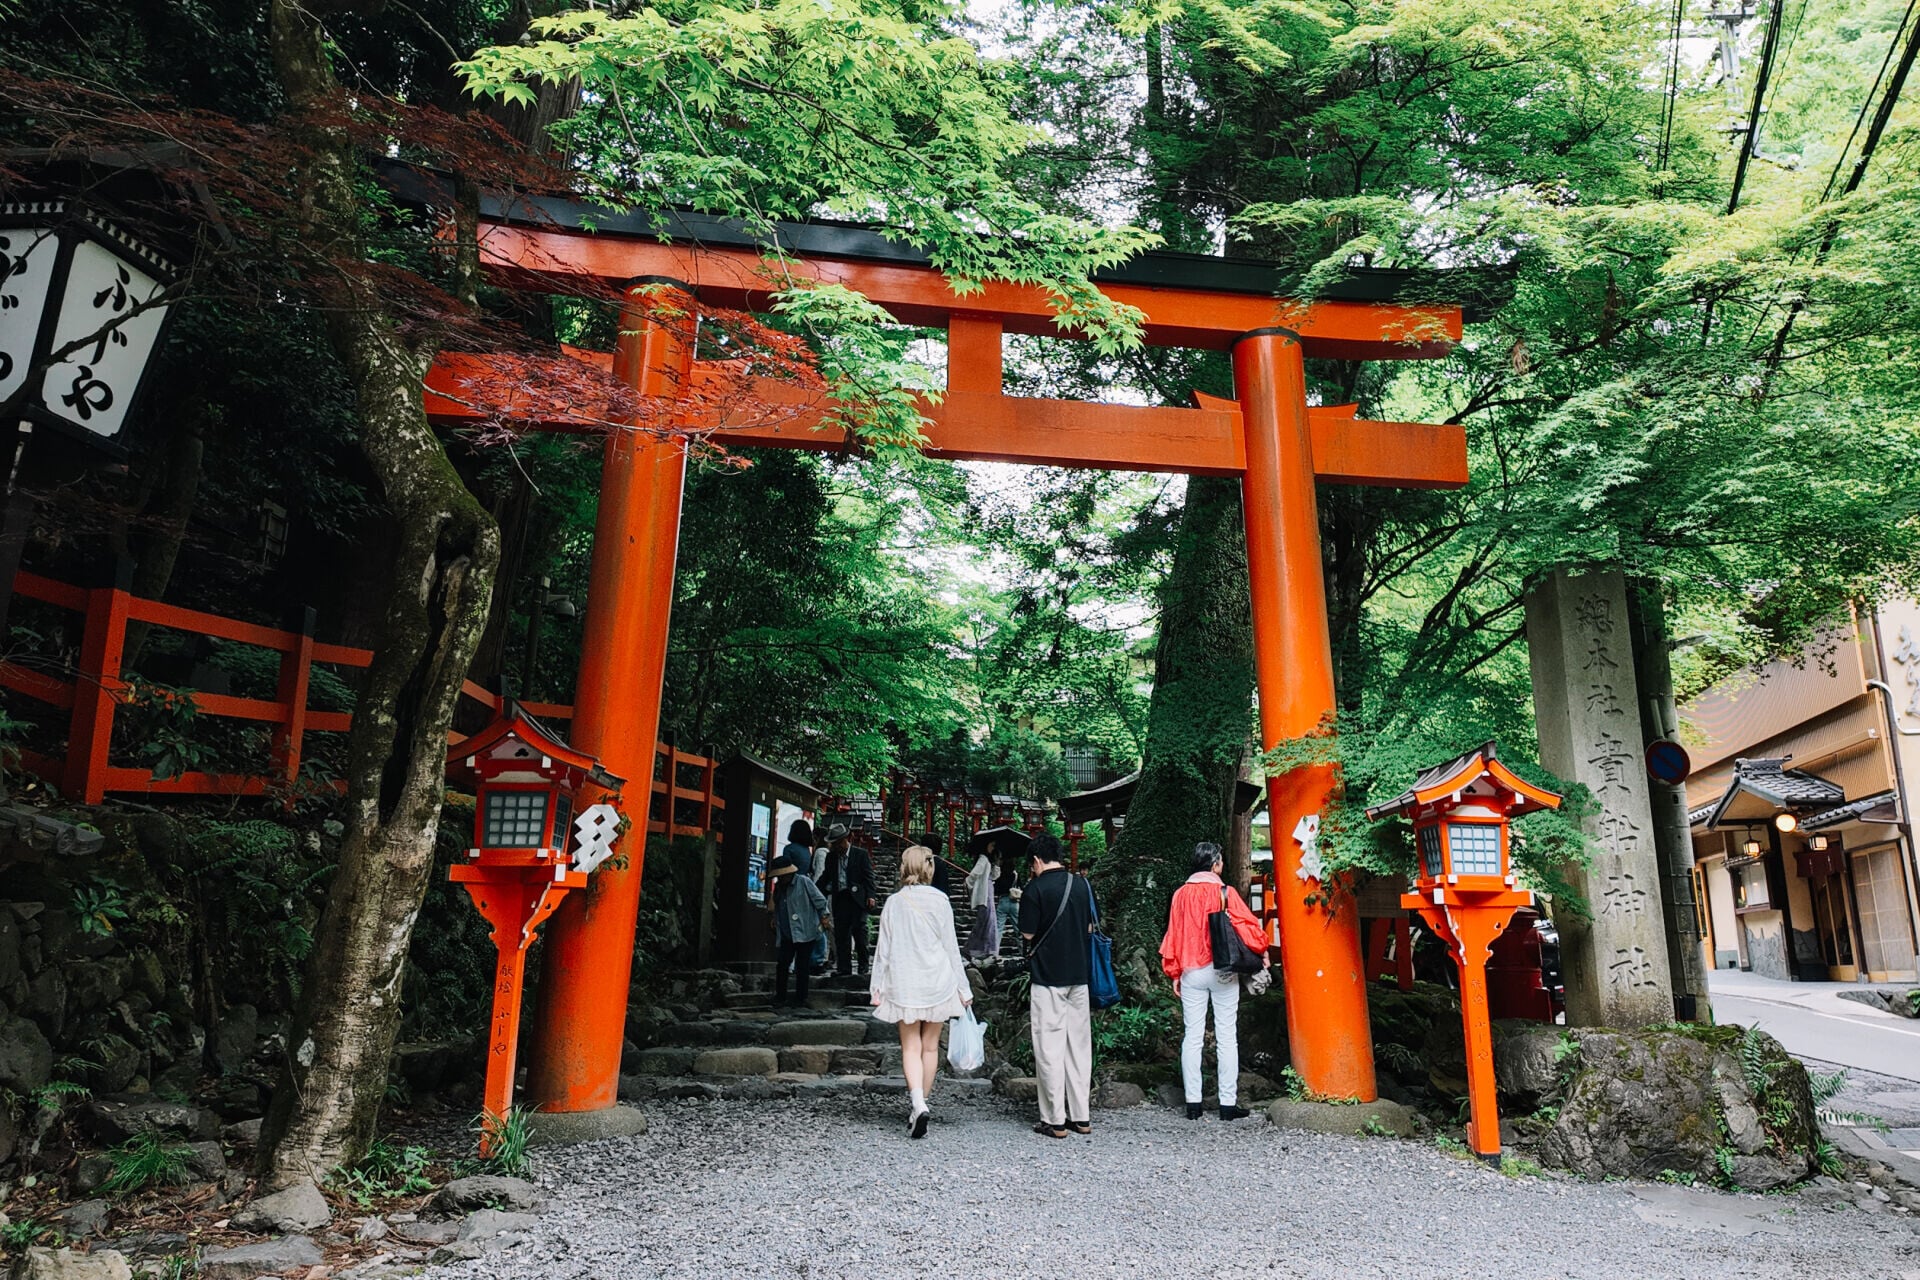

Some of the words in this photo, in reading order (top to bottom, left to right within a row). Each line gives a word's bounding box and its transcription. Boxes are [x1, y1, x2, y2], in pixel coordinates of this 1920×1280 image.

[61, 262, 141, 420] ふじや
[492, 1007, 510, 1056] ふじや
